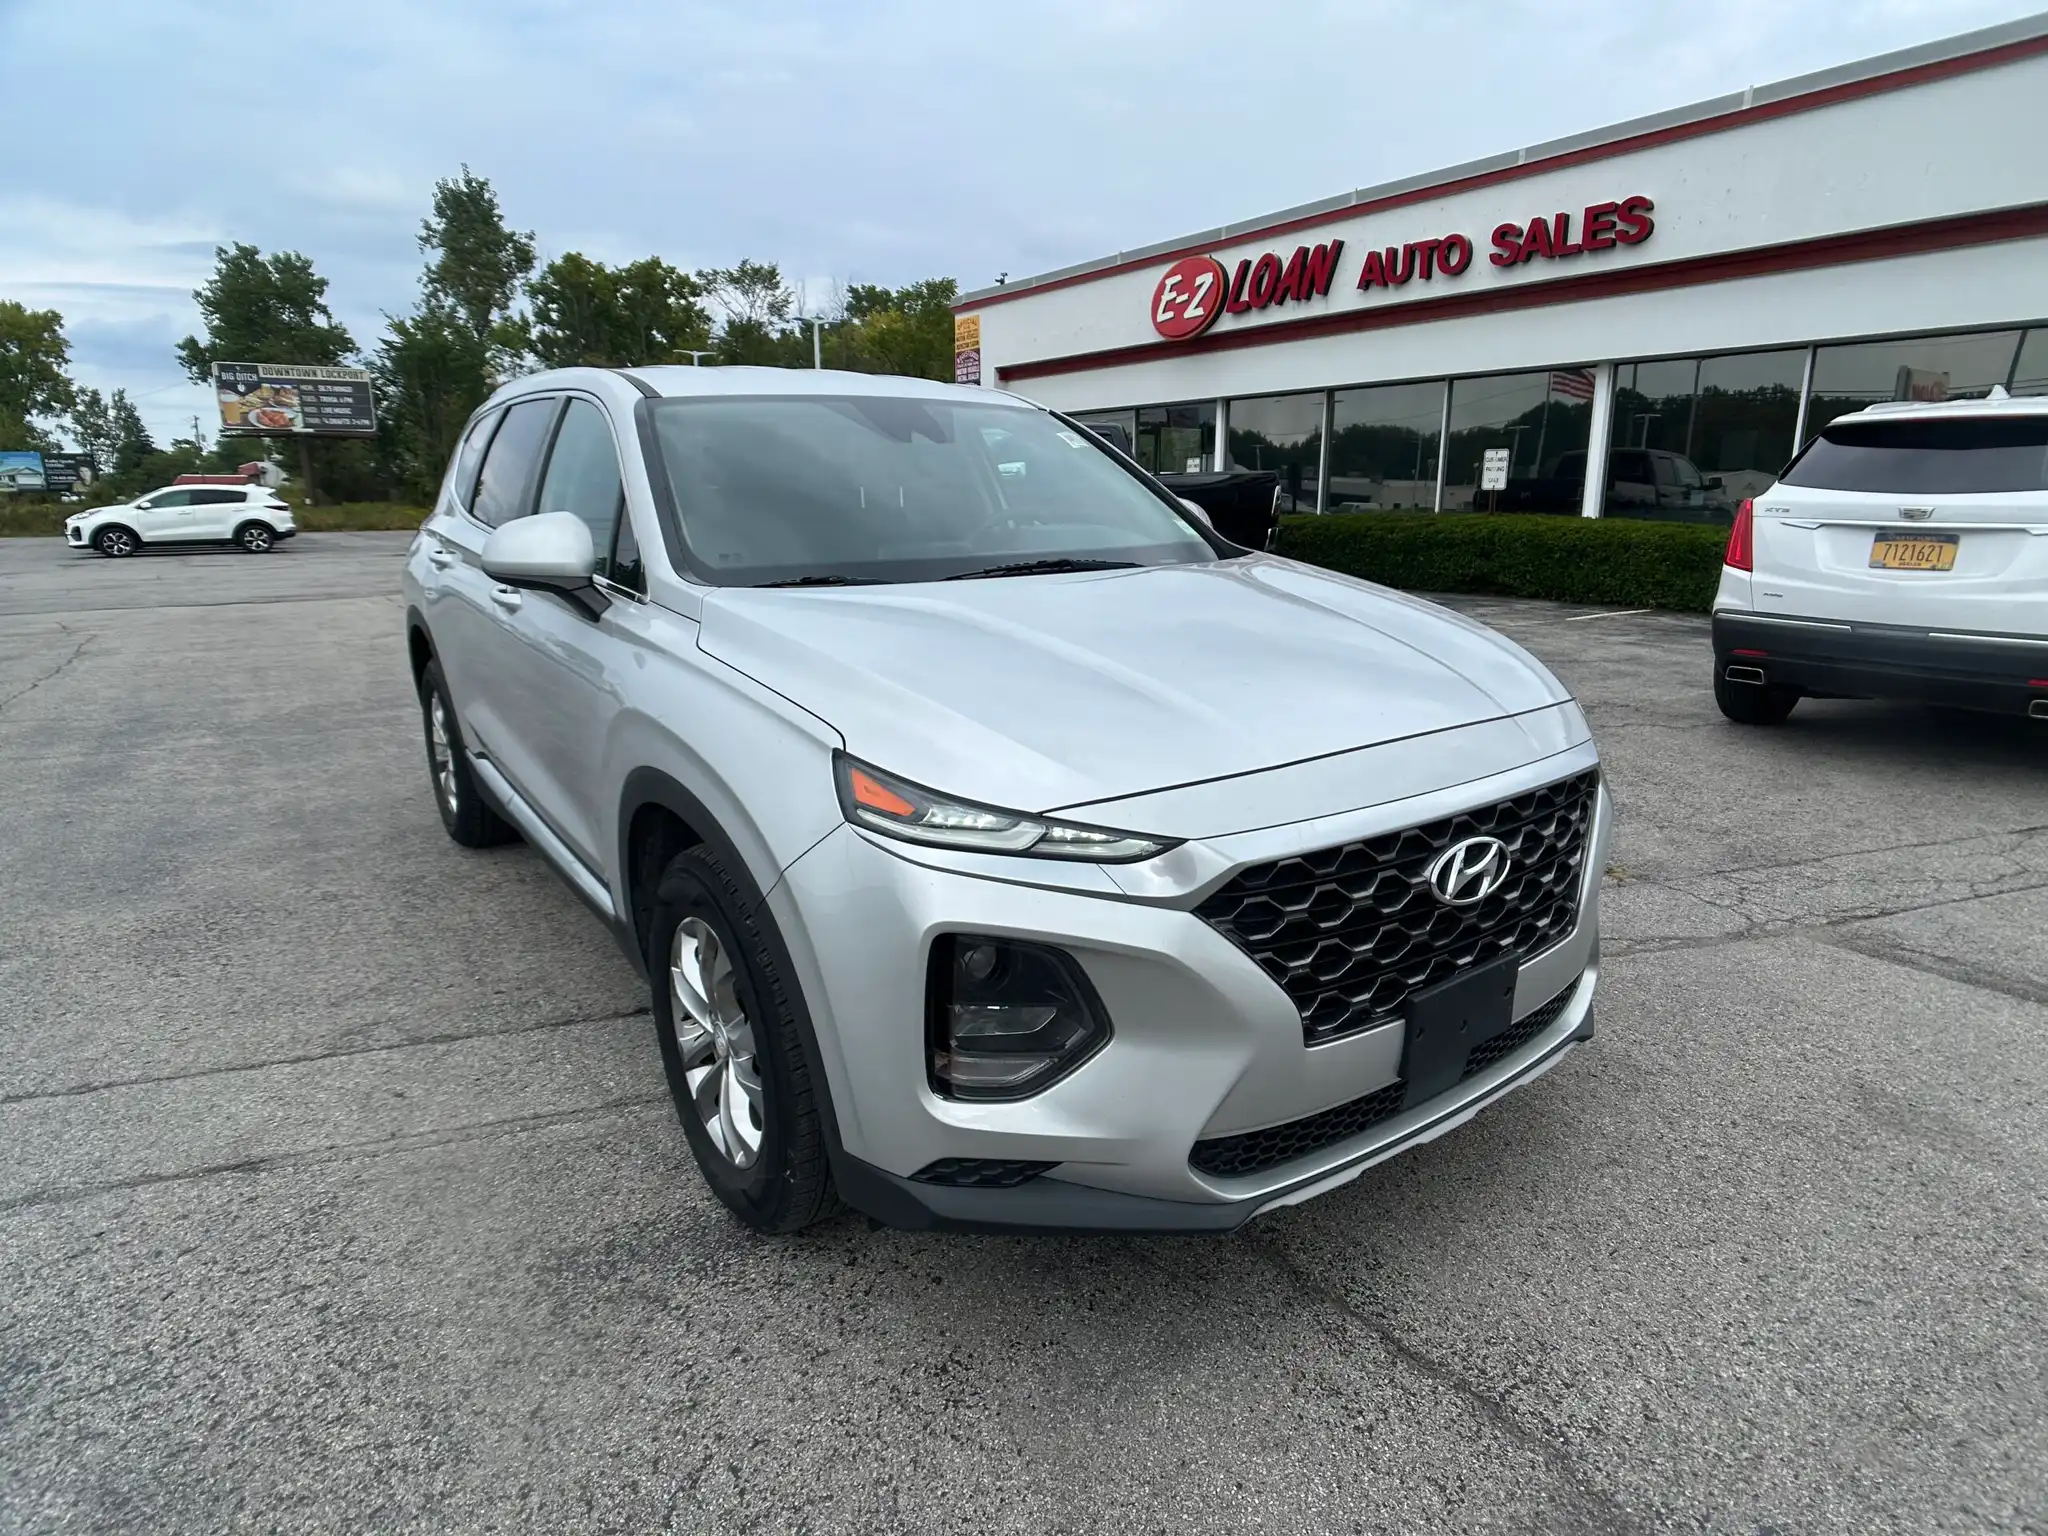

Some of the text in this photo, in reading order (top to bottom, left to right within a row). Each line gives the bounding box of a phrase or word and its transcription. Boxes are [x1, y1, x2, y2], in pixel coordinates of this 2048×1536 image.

[1156, 195, 1655, 325] E-Z LOAN AUTO SALES
[221, 371, 258, 382] BIG DITCH
[262, 366, 364, 381] DOWNTOWN LOCKPORT
[1883, 543, 1944, 563] 7121621
